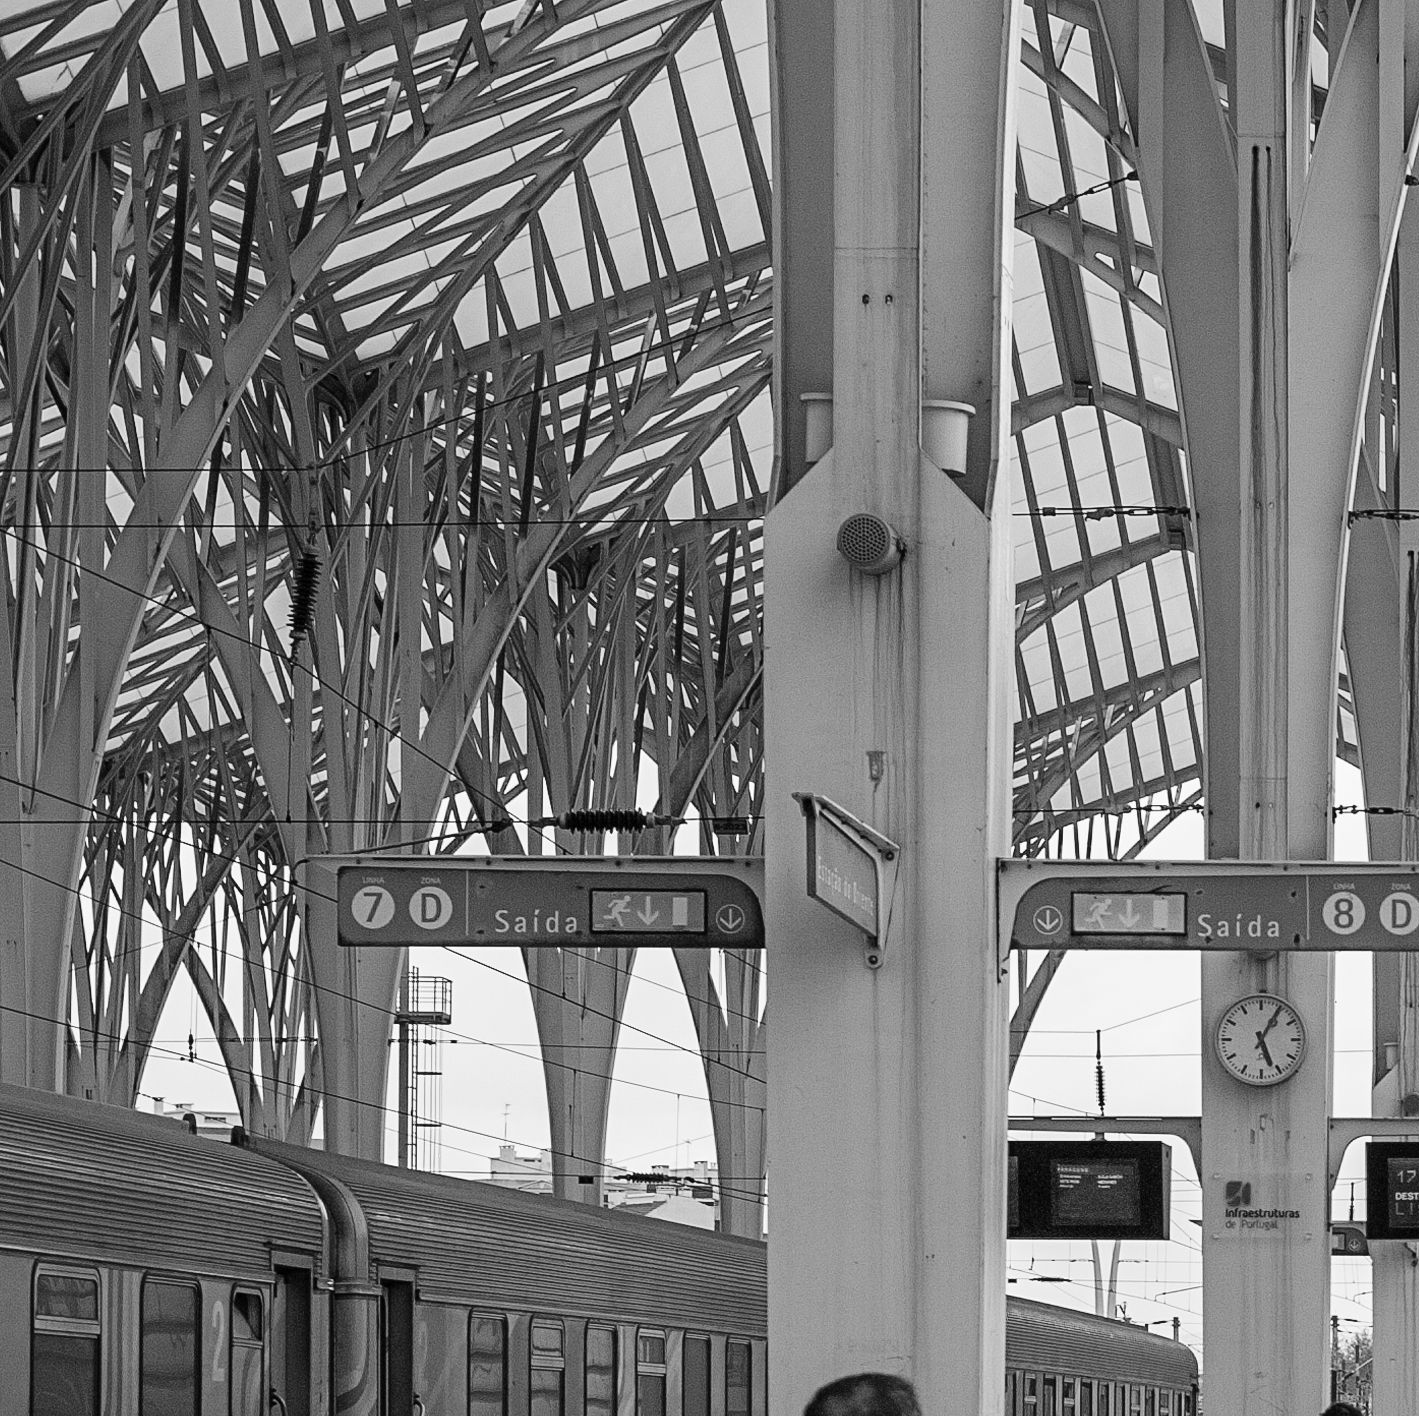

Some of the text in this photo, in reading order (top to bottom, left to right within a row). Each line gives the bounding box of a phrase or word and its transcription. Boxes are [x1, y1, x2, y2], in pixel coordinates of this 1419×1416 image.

[420, 876, 442, 885] ZONA
[362, 892, 442, 923] 7 D
[1333, 898, 1412, 929] 8 D
[494, 910, 578, 934] Saída
[1197, 913, 1281, 938] Saída
[1225, 1208, 1301, 1219] Infraestruturas
[1225, 1219, 1279, 1231] de Portugal
[211, 1300, 225, 1382] 2
